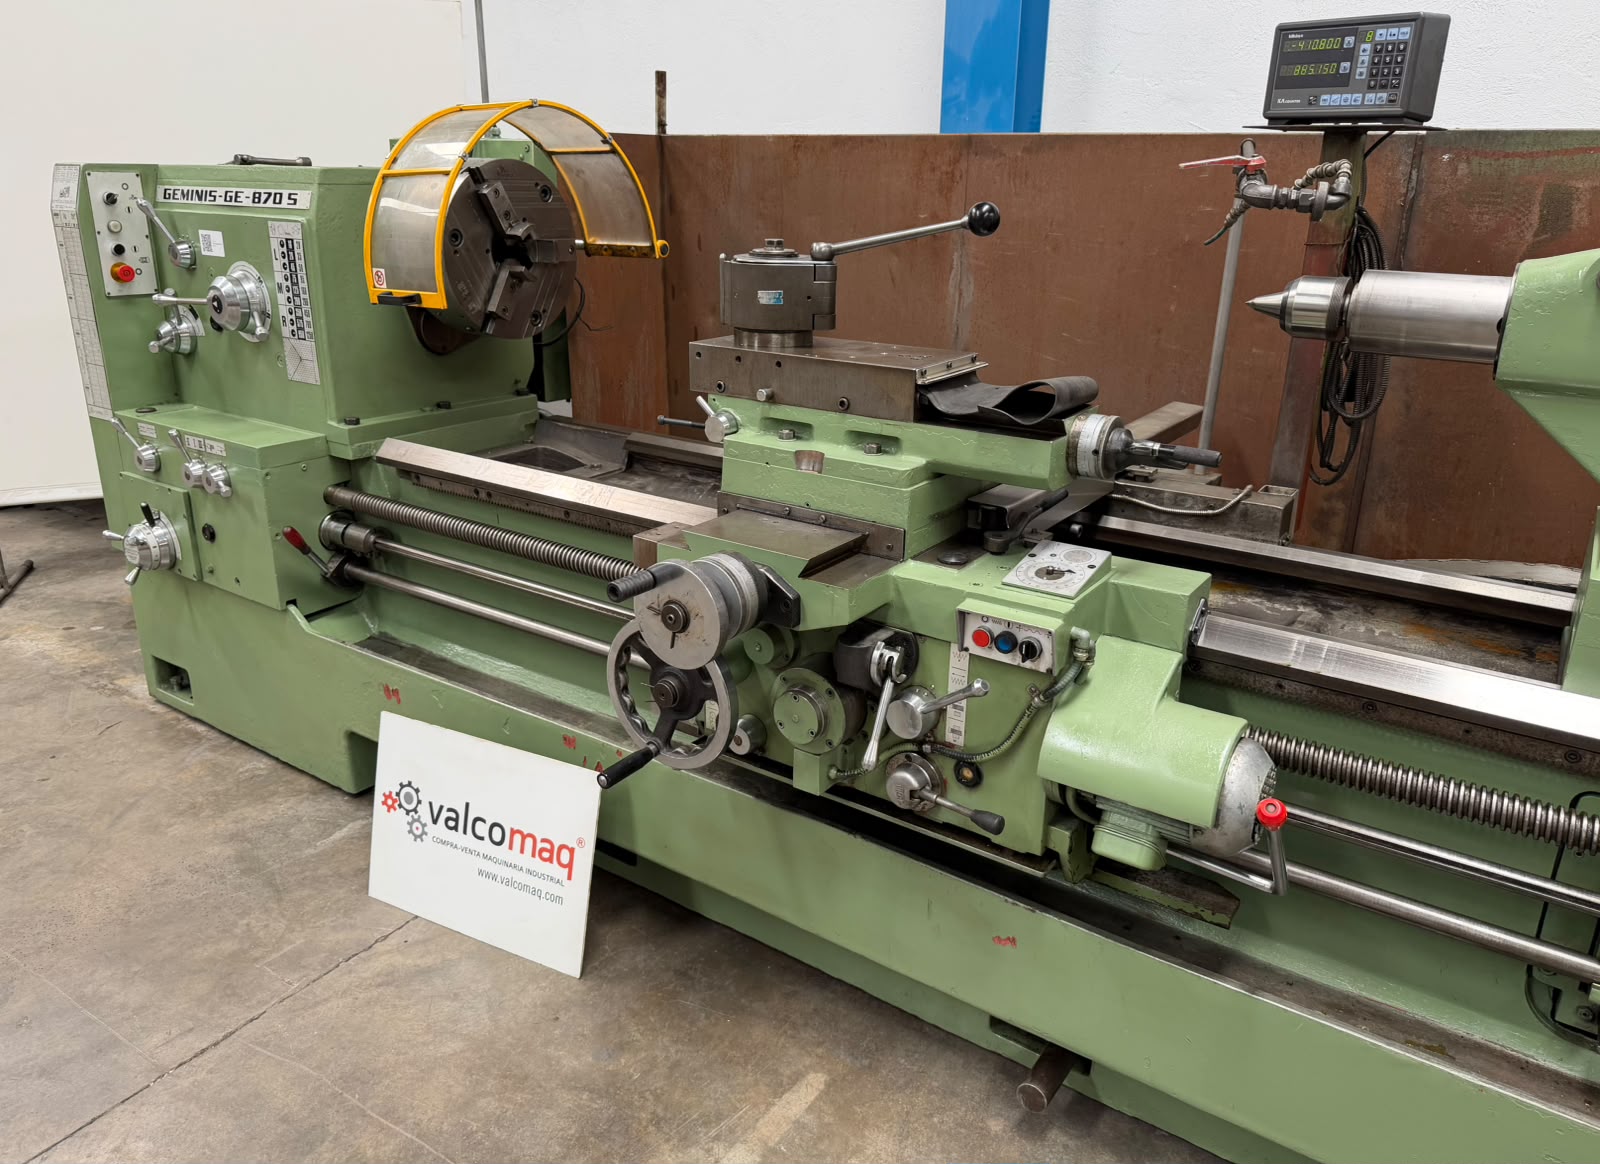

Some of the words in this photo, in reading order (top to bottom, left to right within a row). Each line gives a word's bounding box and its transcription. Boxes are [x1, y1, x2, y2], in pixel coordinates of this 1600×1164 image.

[1365, 30, 1375, 42] 8
[163, 188, 283, 205] GEMINIS-GE-870
[287, 192, 299, 205] S
[273, 248, 279, 261] L
[276, 282, 284, 294] M
[281, 316, 288, 327] R
[431, 835, 481, 858] COMPRA-VENTA
[482, 853, 524, 873] MAQUINARIA
[525, 867, 565, 888] INDUSTRIAL
[477, 867, 564, 906] www.valcomaq.com
